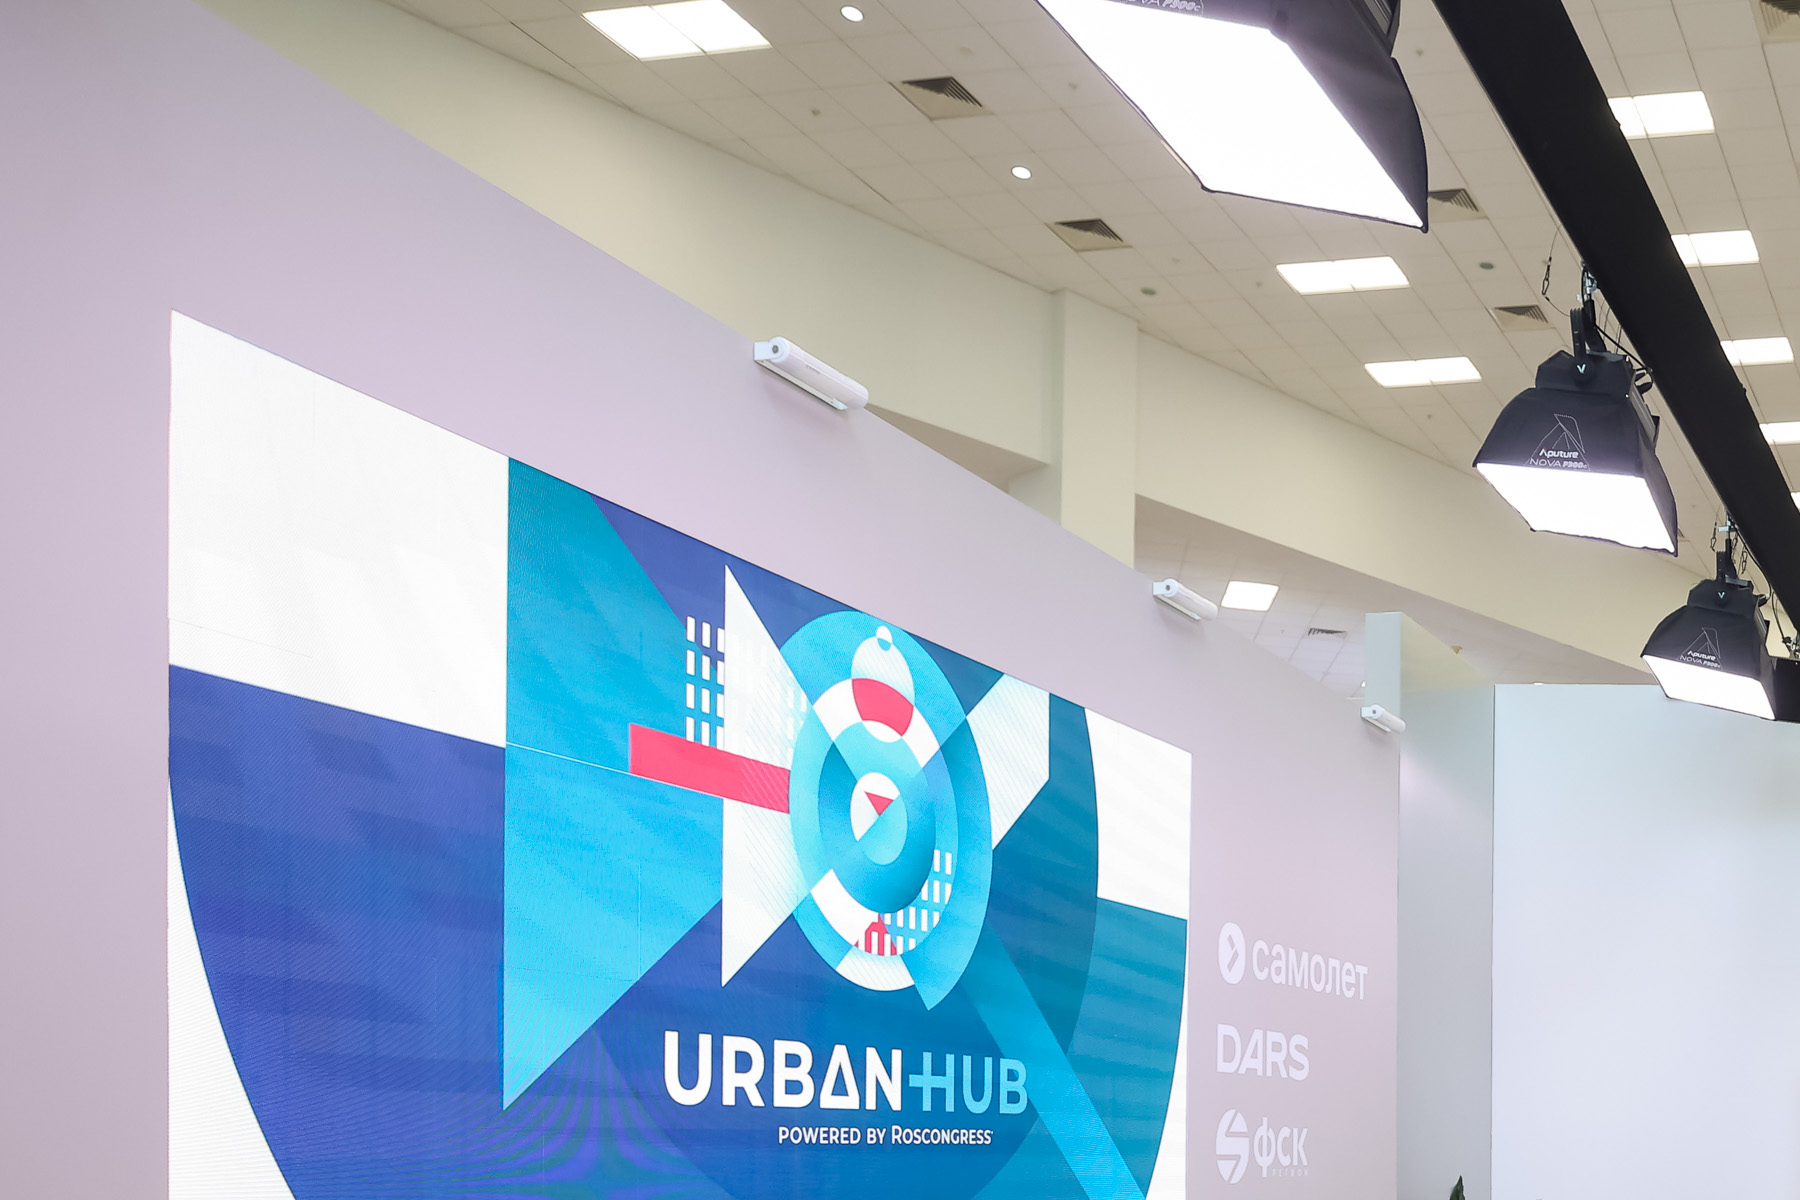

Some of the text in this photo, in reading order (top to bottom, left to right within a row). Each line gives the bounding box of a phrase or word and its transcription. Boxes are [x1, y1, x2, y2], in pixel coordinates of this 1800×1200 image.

[1529, 457, 1562, 467] NOVA
[1539, 448, 1579, 458] Aputure
[1252, 939, 1369, 1000] самолет
[1216, 1023, 1311, 1081] DARS
[778, 1126, 862, 1145] POWERED
[866, 1126, 887, 1144] BY
